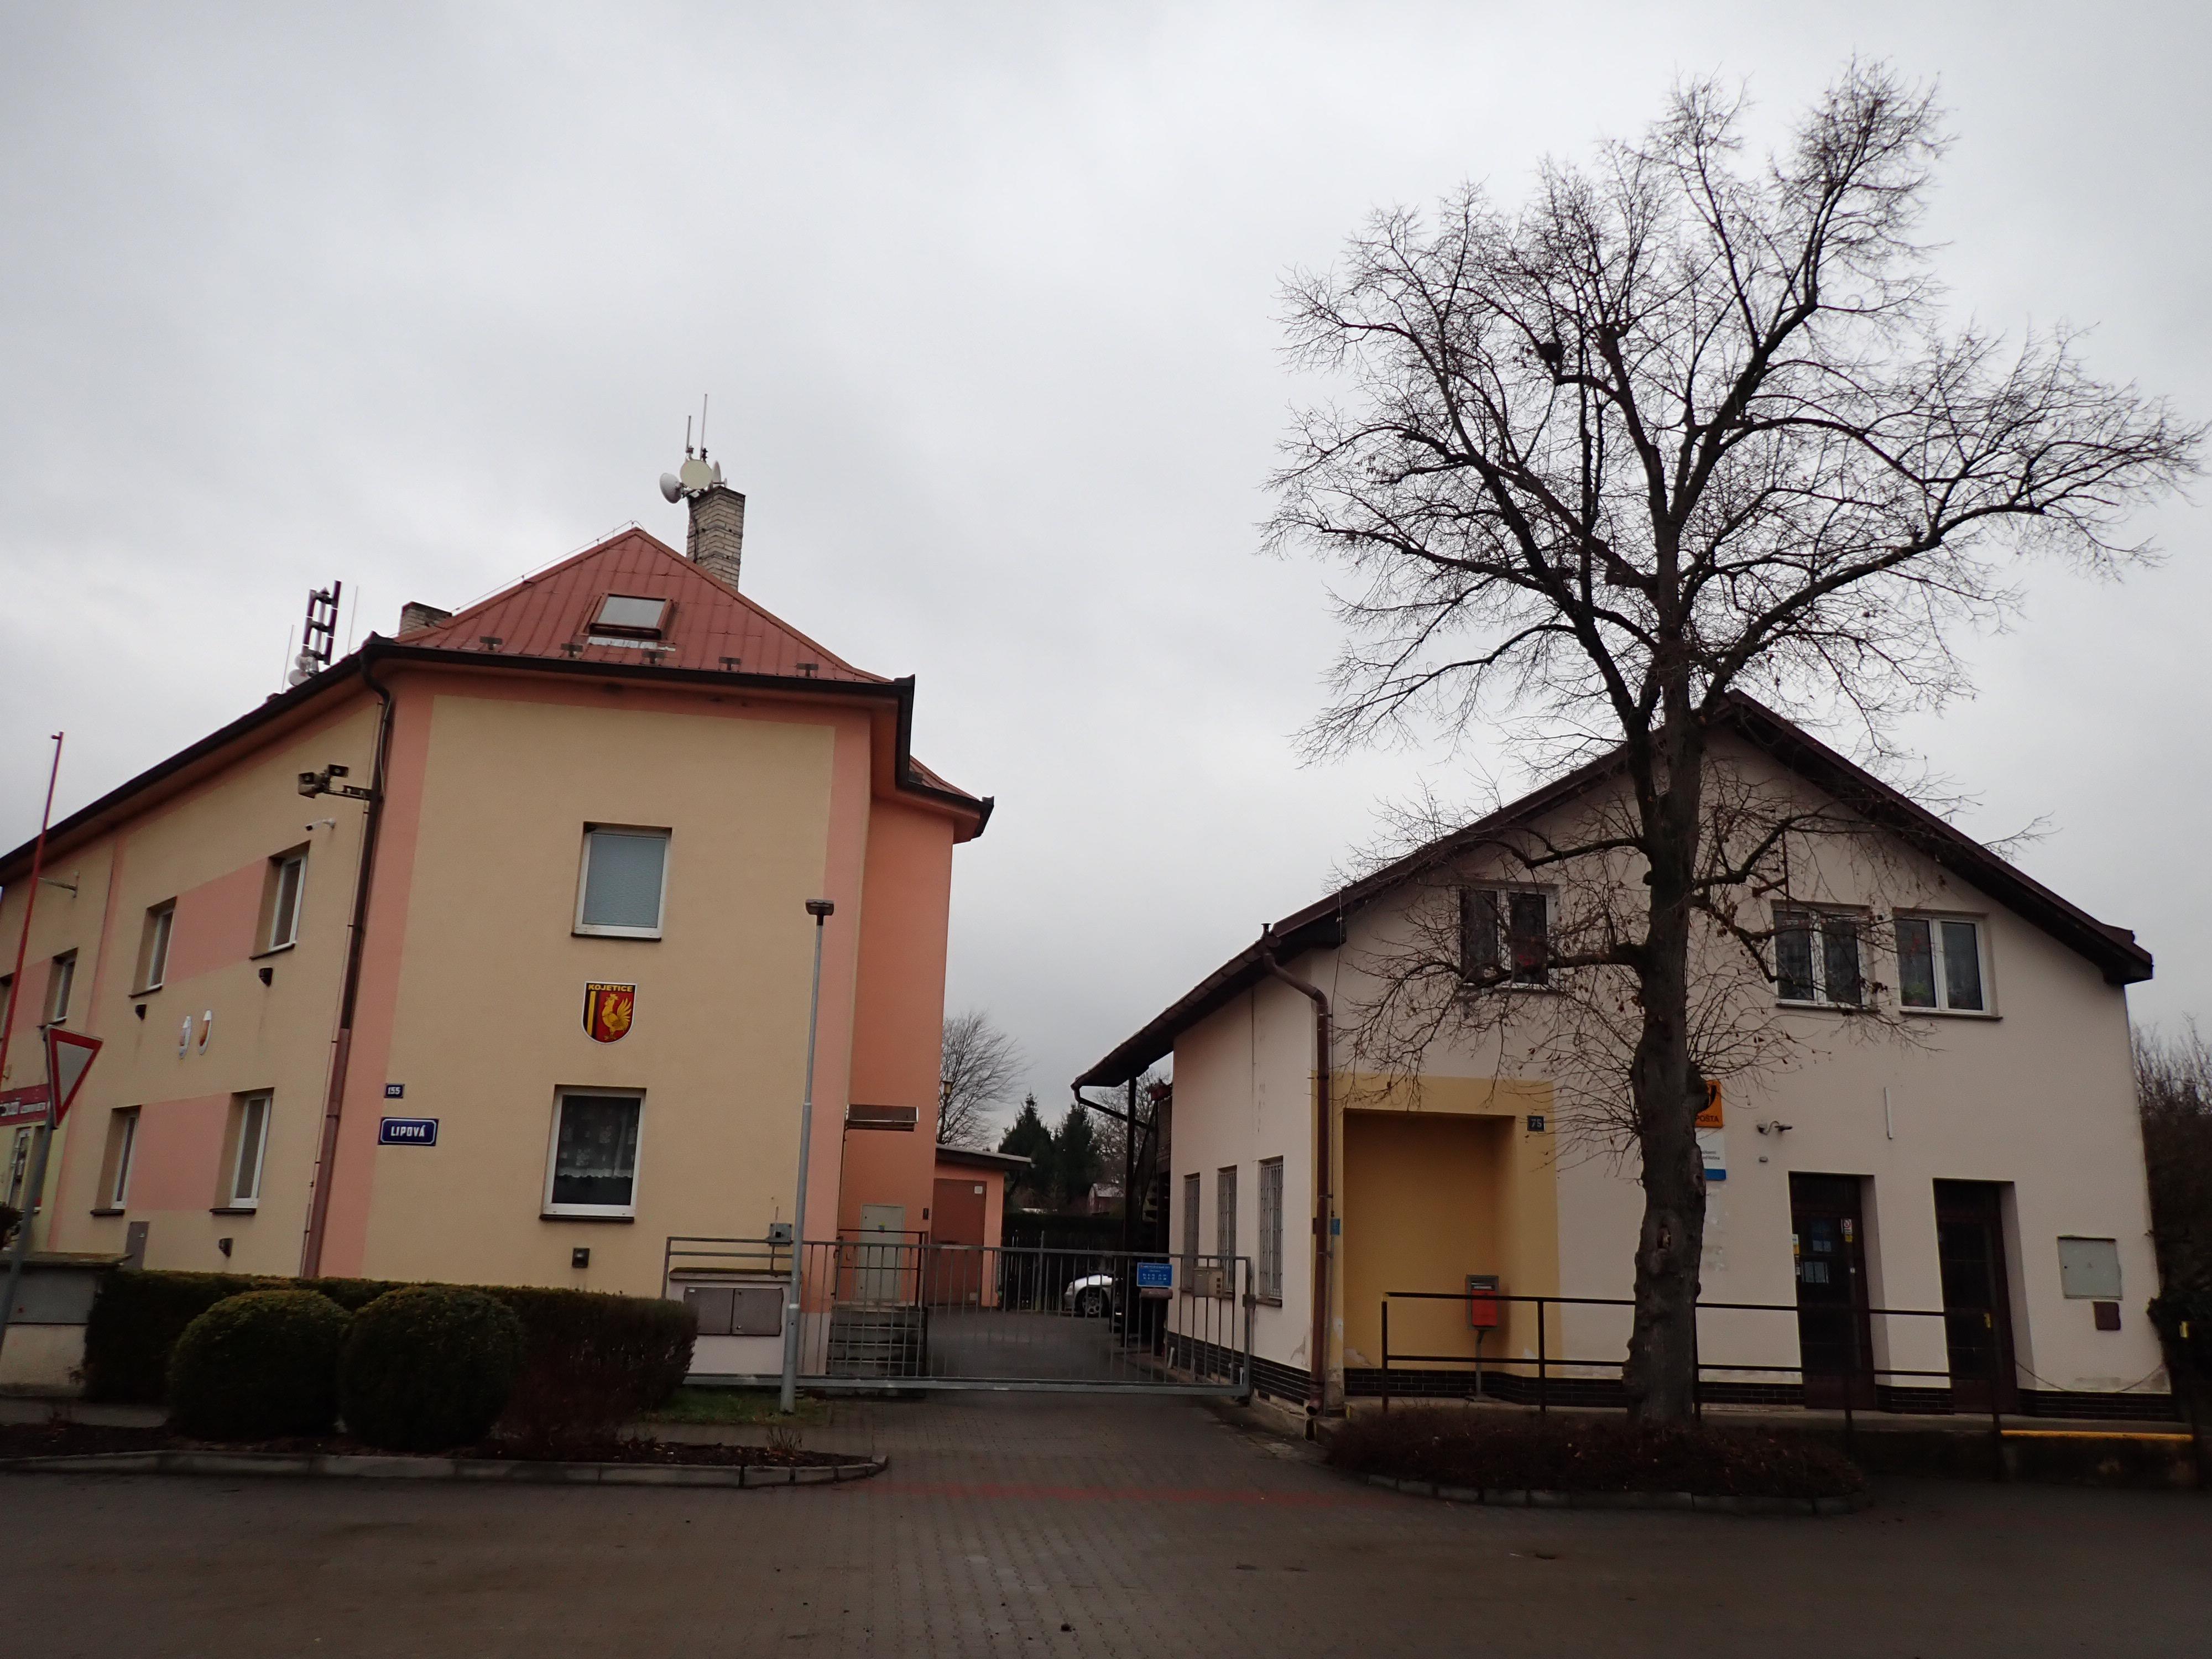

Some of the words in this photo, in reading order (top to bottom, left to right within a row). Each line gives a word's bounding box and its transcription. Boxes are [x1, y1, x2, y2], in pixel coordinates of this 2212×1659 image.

[388, 1087, 401, 1095] 155
[1531, 1119, 1542, 1128] 75
[390, 1125, 426, 1137] LIPOVÁ
